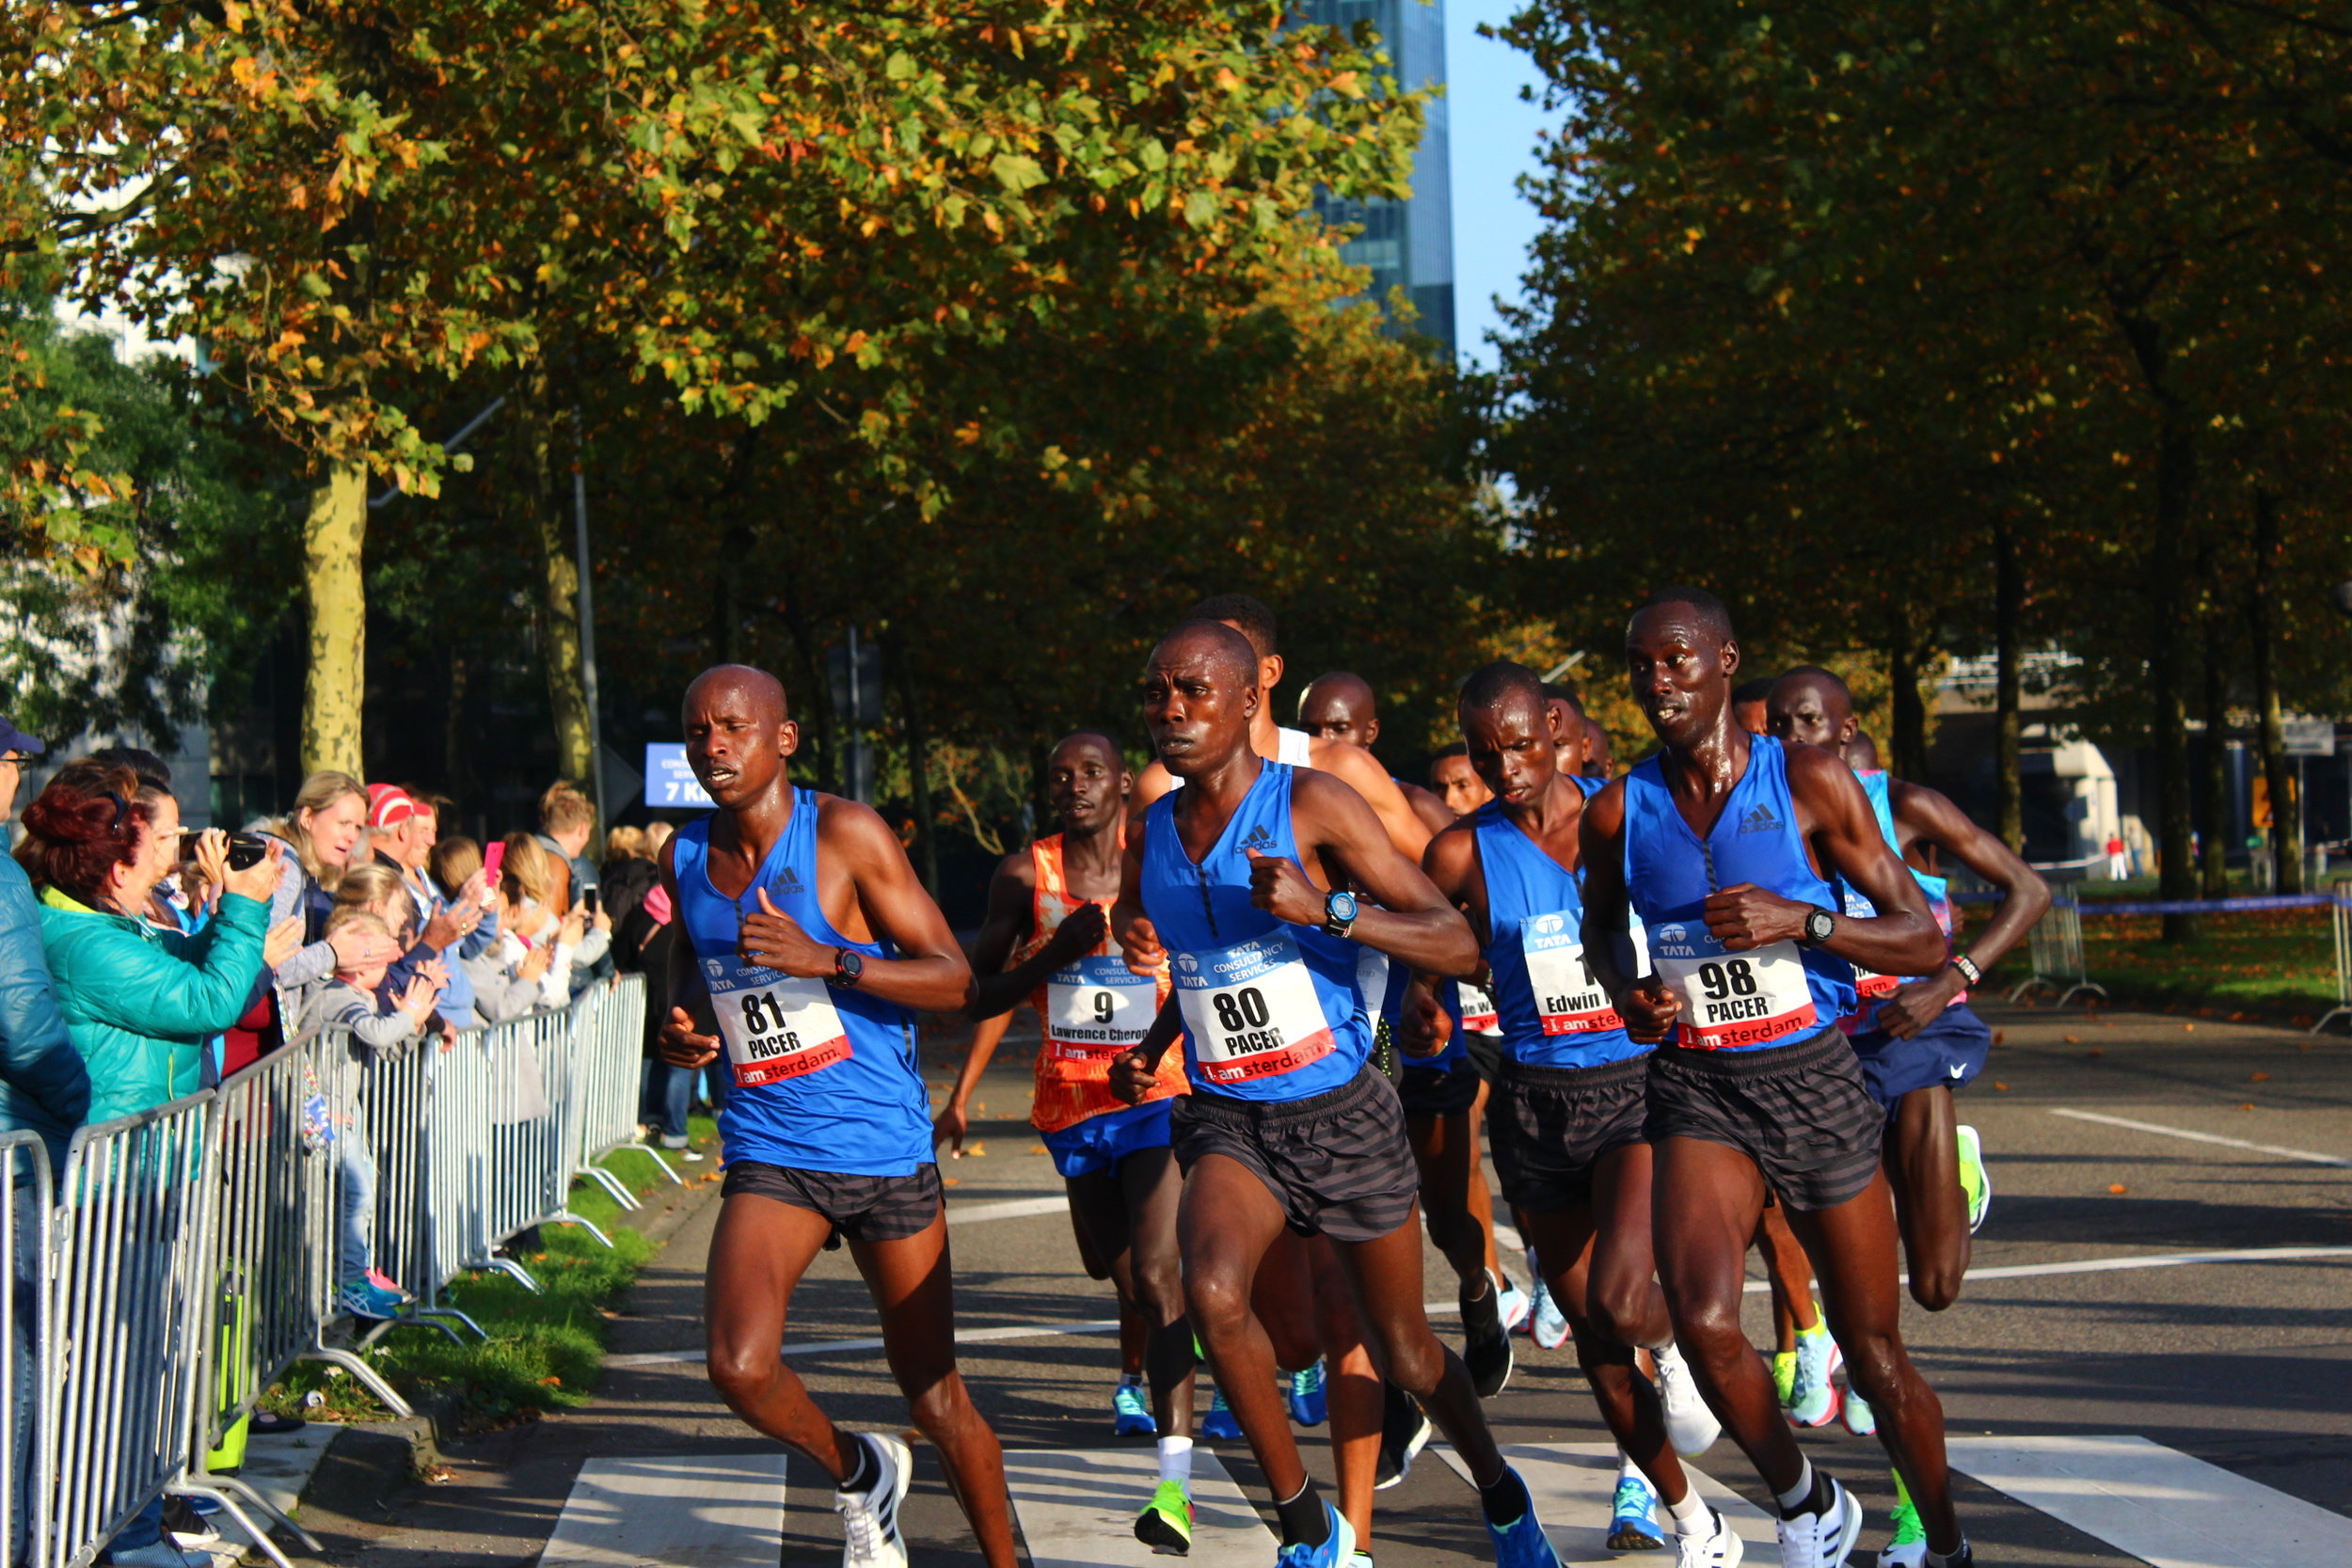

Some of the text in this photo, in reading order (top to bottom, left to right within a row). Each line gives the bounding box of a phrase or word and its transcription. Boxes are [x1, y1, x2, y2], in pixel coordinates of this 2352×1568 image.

[664, 782, 679, 802] 7
[1740, 820, 1784, 834] adidas
[1234, 840, 1278, 854] adidas
[768, 883, 804, 897] adidas
[1227, 941, 1262, 959] TATA
[1534, 934, 1572, 949] TATA
[1214, 942, 1284, 974] CONSULTANCY
[1659, 945, 1696, 957] TATA
[750, 970, 787, 986] SERVIC
[1056, 973, 1086, 985] TATA
[1094, 966, 1129, 975] CONSUL
[1230, 959, 1278, 983] SERVICES
[1698, 958, 1757, 1000] 98
[710, 979, 736, 991] TATA
[1104, 975, 1142, 985] SERVICES
[1181, 975, 1209, 988] TATA
[1093, 991, 1114, 1024] 9
[1213, 987, 1270, 1033] 80
[1546, 991, 1600, 1013] Edwin
[1706, 997, 1769, 1022] PACER
[740, 990, 787, 1036] 81
[1051, 1024, 1149, 1041] Lawrence Cheron
[748, 1031, 802, 1059] PACER
[1225, 1027, 1285, 1056] PACER
